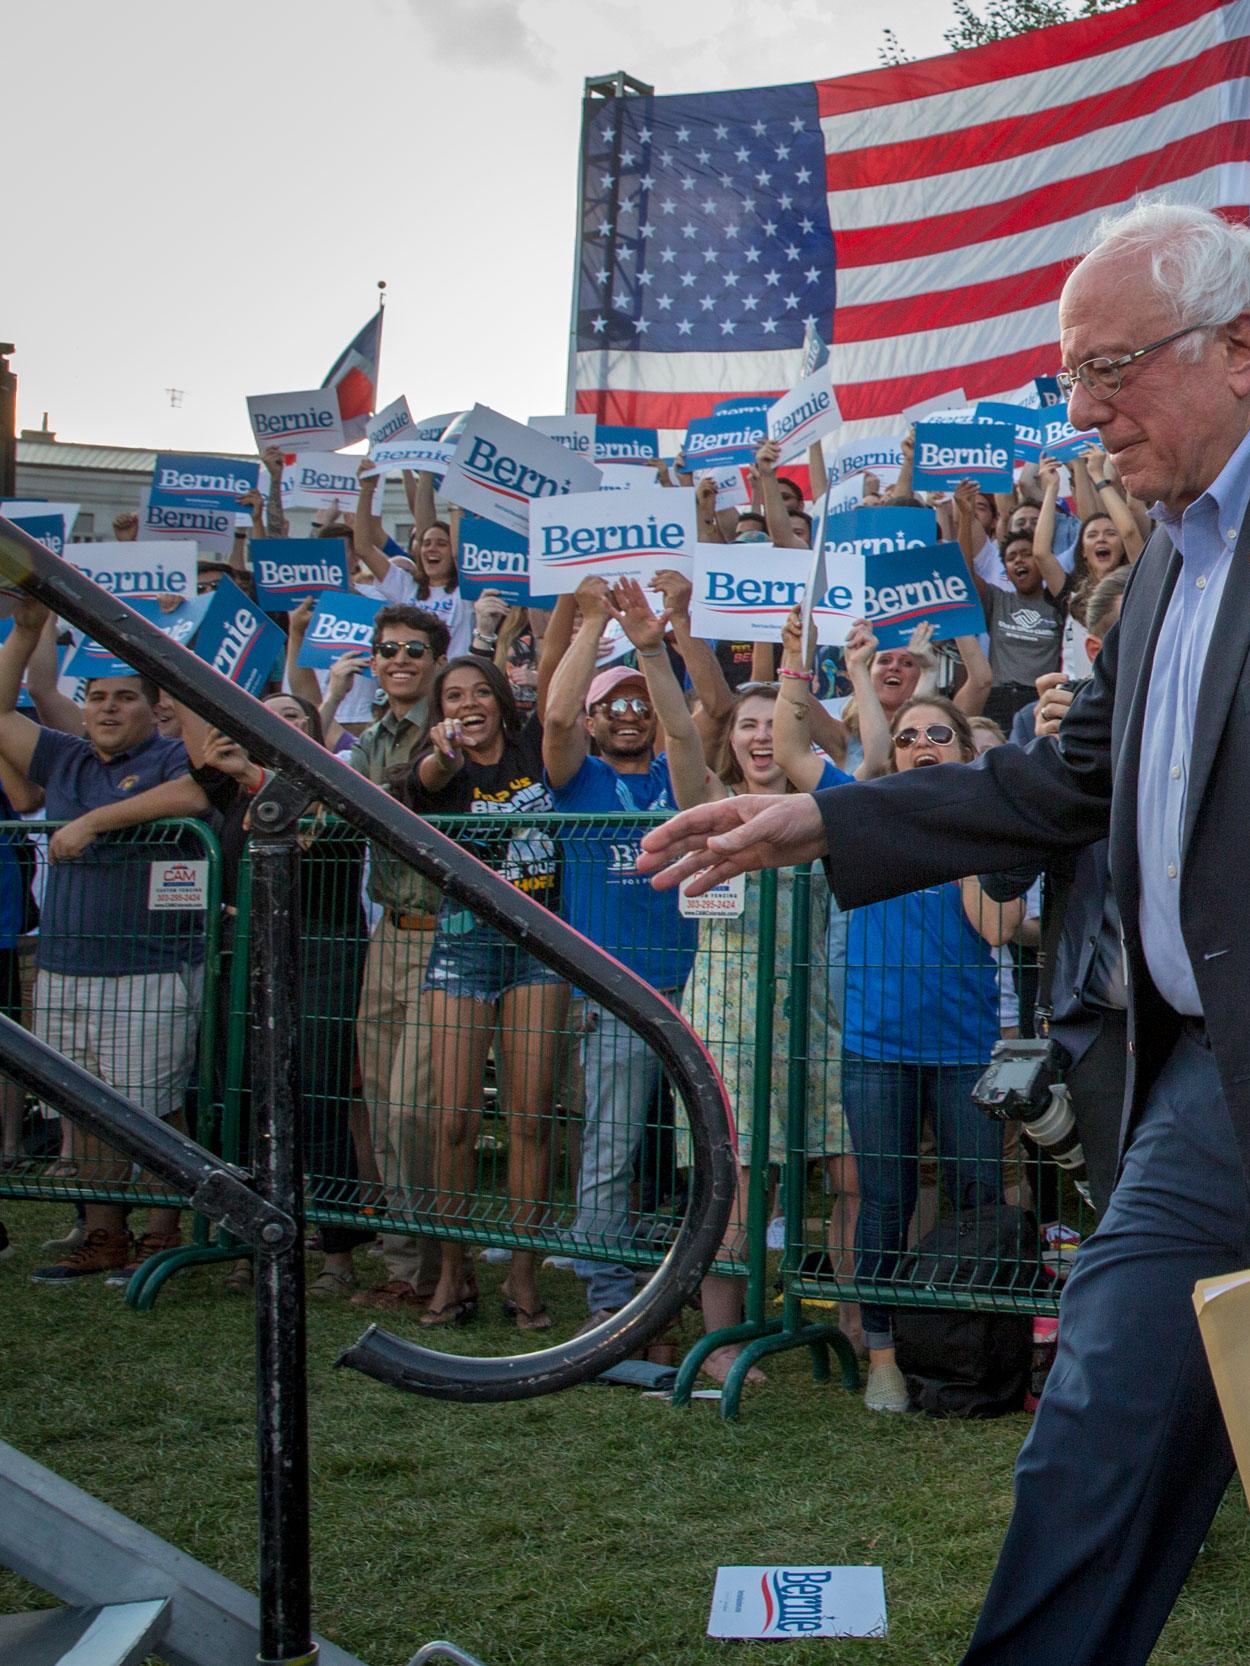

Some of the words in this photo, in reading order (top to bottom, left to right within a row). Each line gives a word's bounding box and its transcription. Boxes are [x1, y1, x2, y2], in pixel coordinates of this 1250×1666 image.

[254, 407, 334, 433] Bernie
[772, 390, 830, 438] Bernie
[595, 441, 653, 458] ernie
[687, 427, 764, 451] Bernie
[842, 449, 904, 474] Bernie
[920, 443, 1008, 467] Bernie
[159, 469, 251, 492] Bernie
[302, 468, 357, 490] Bern
[145, 505, 229, 532] Bernie
[541, 514, 685, 556] Bernie
[462, 543, 528, 574] Bern
[259, 559, 343, 584] Bernie
[865, 570, 968, 616] Bernie
[212, 608, 258, 680] rnie
[163, 870, 196, 881] CAM
[777, 1571, 840, 1633] Bernie
